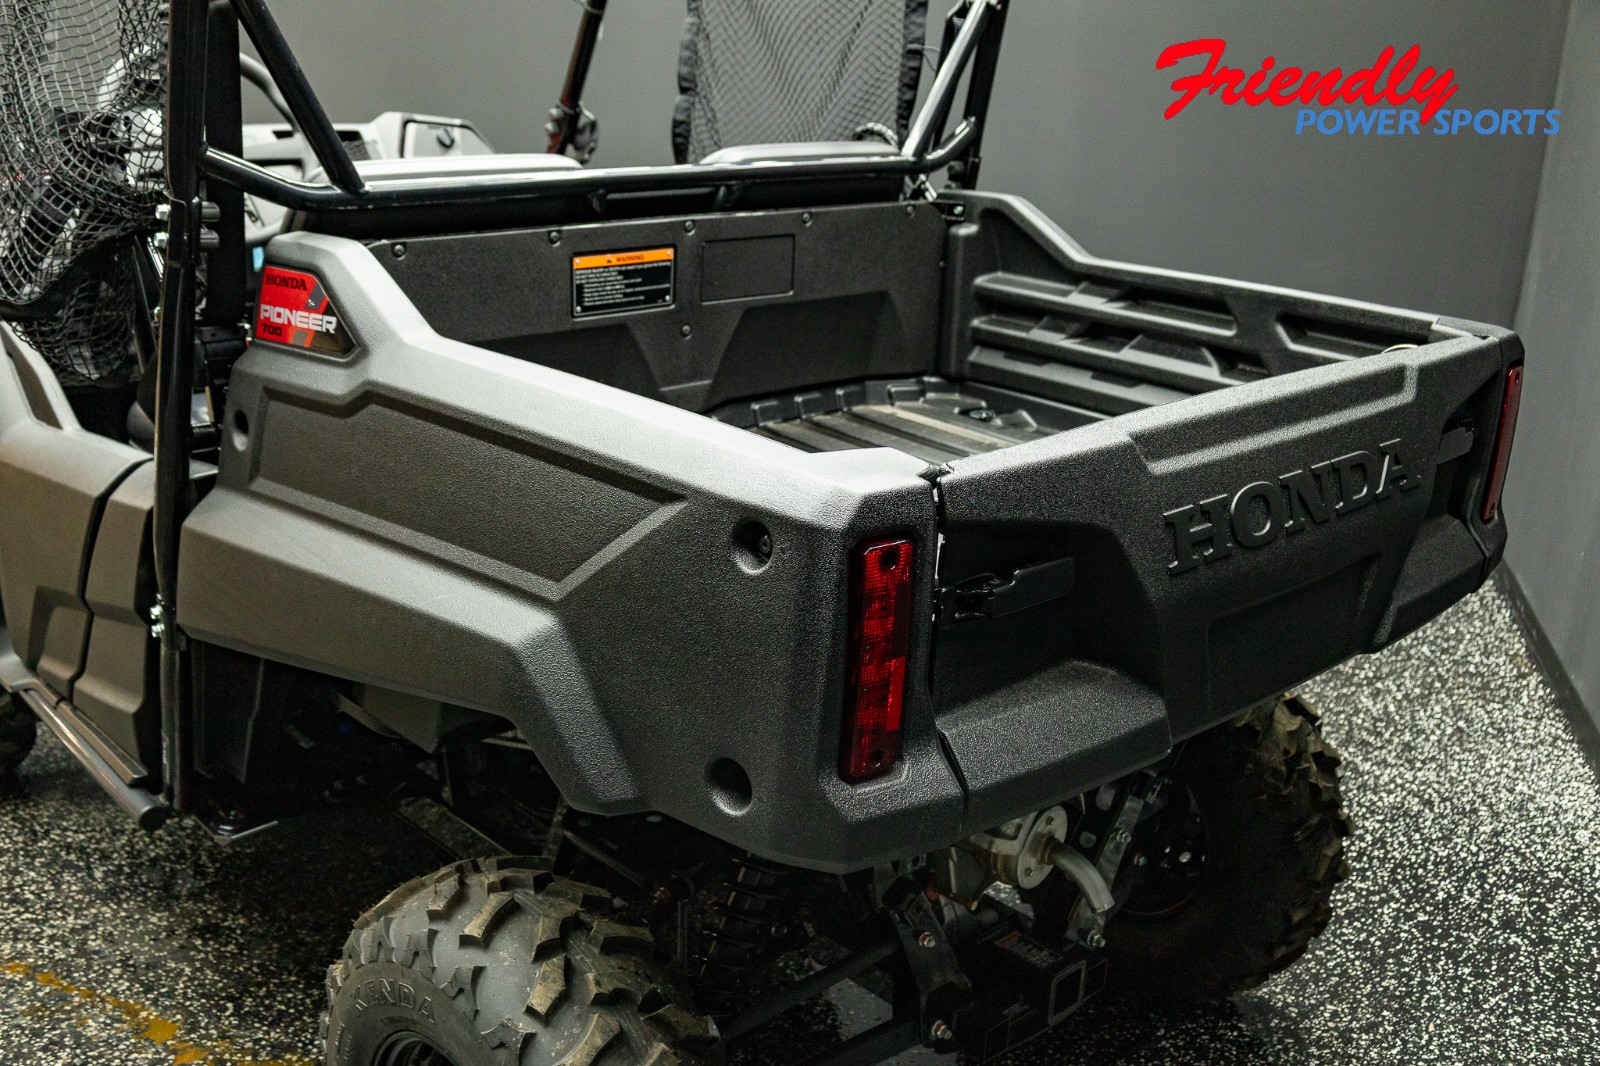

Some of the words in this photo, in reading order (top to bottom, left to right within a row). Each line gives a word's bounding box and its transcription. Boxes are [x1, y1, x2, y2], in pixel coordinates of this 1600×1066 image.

[616, 254, 644, 263] WARNING
[265, 274, 308, 291] HONDA
[260, 304, 337, 334] PIONEER
[261, 323, 283, 337] 700
[1163, 438, 1421, 576] HONDA
[349, 978, 435, 1024] KENDA
